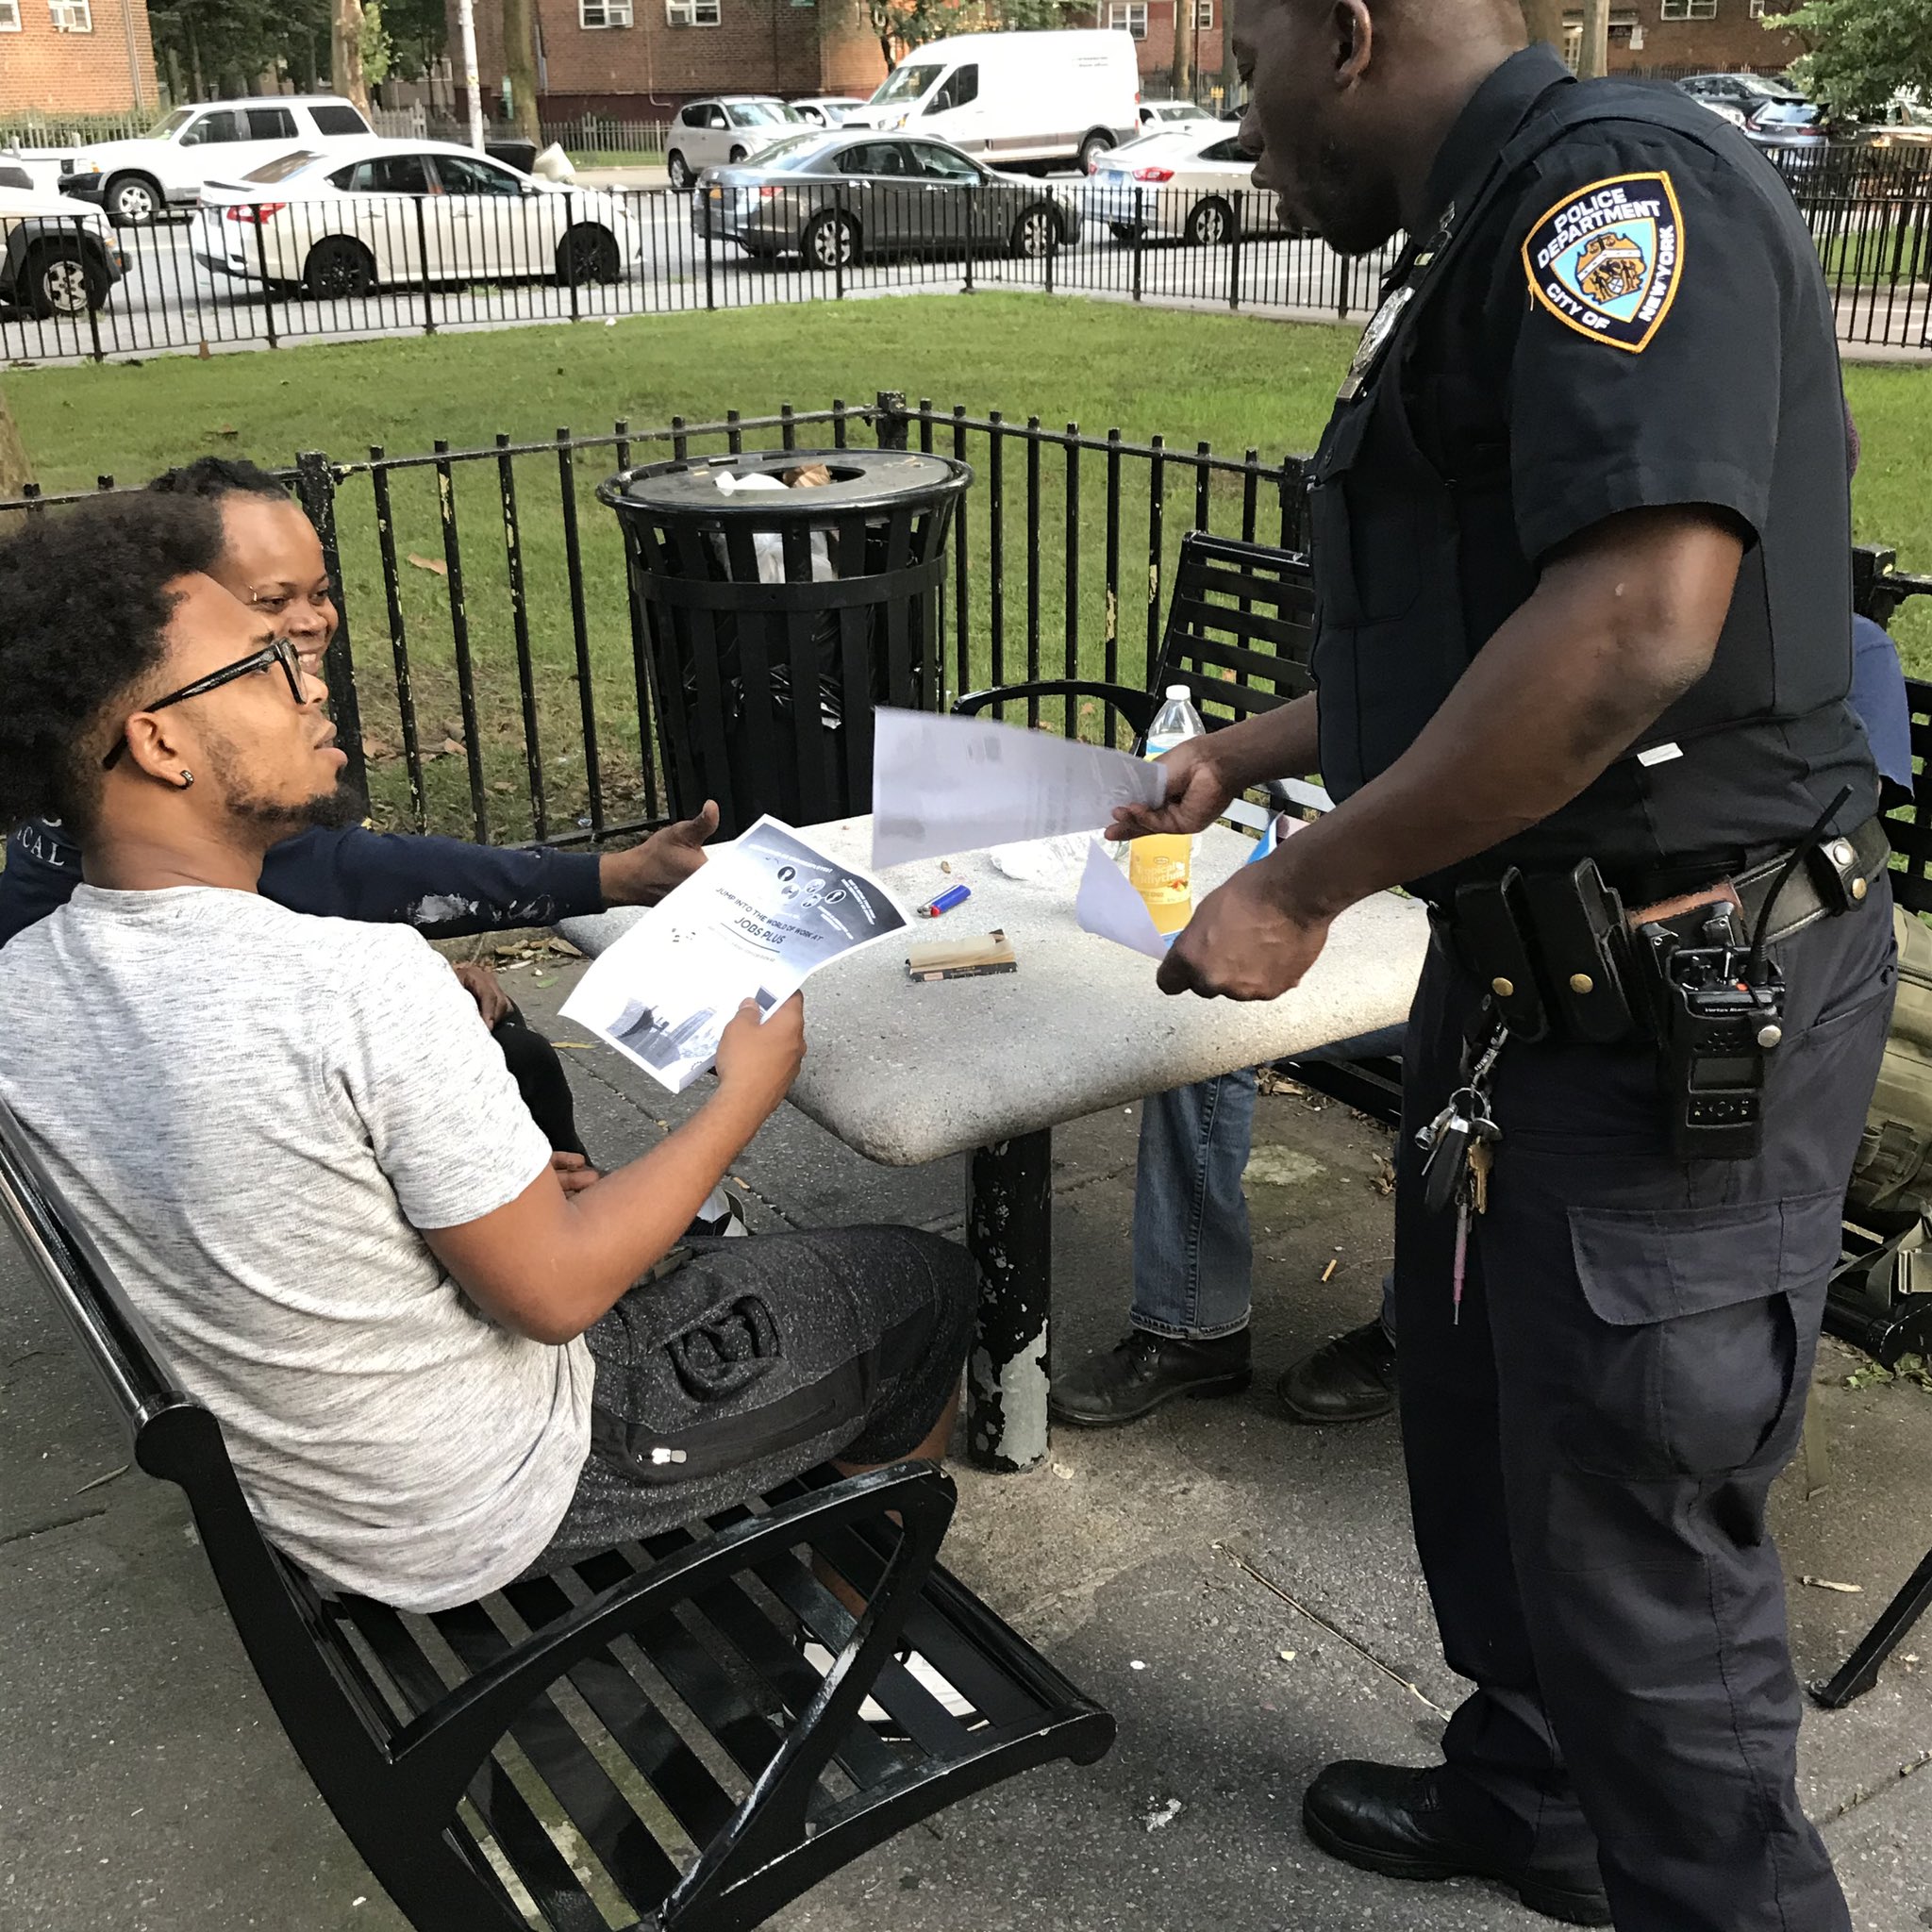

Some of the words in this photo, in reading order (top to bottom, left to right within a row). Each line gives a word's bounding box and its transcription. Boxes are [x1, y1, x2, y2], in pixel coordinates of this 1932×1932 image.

[1537, 200, 1660, 269] DEPARTMENT
[1554, 188, 1627, 233] POLICE
[1639, 275, 1667, 323] NEW
[1657, 225, 1675, 277] YORK
[1546, 283, 1583, 316] CITY
[1581, 310, 1610, 330] OF
[715, 887, 736, 900] JUMP
[734, 898, 753, 912] INTO
[753, 909, 767, 922] THE
[766, 919, 787, 930] WORLD
[794, 926, 812, 938] WORK
[811, 932, 824, 941] AT
[734, 917, 763, 936] JOBS
[760, 930, 787, 944] PLUS
